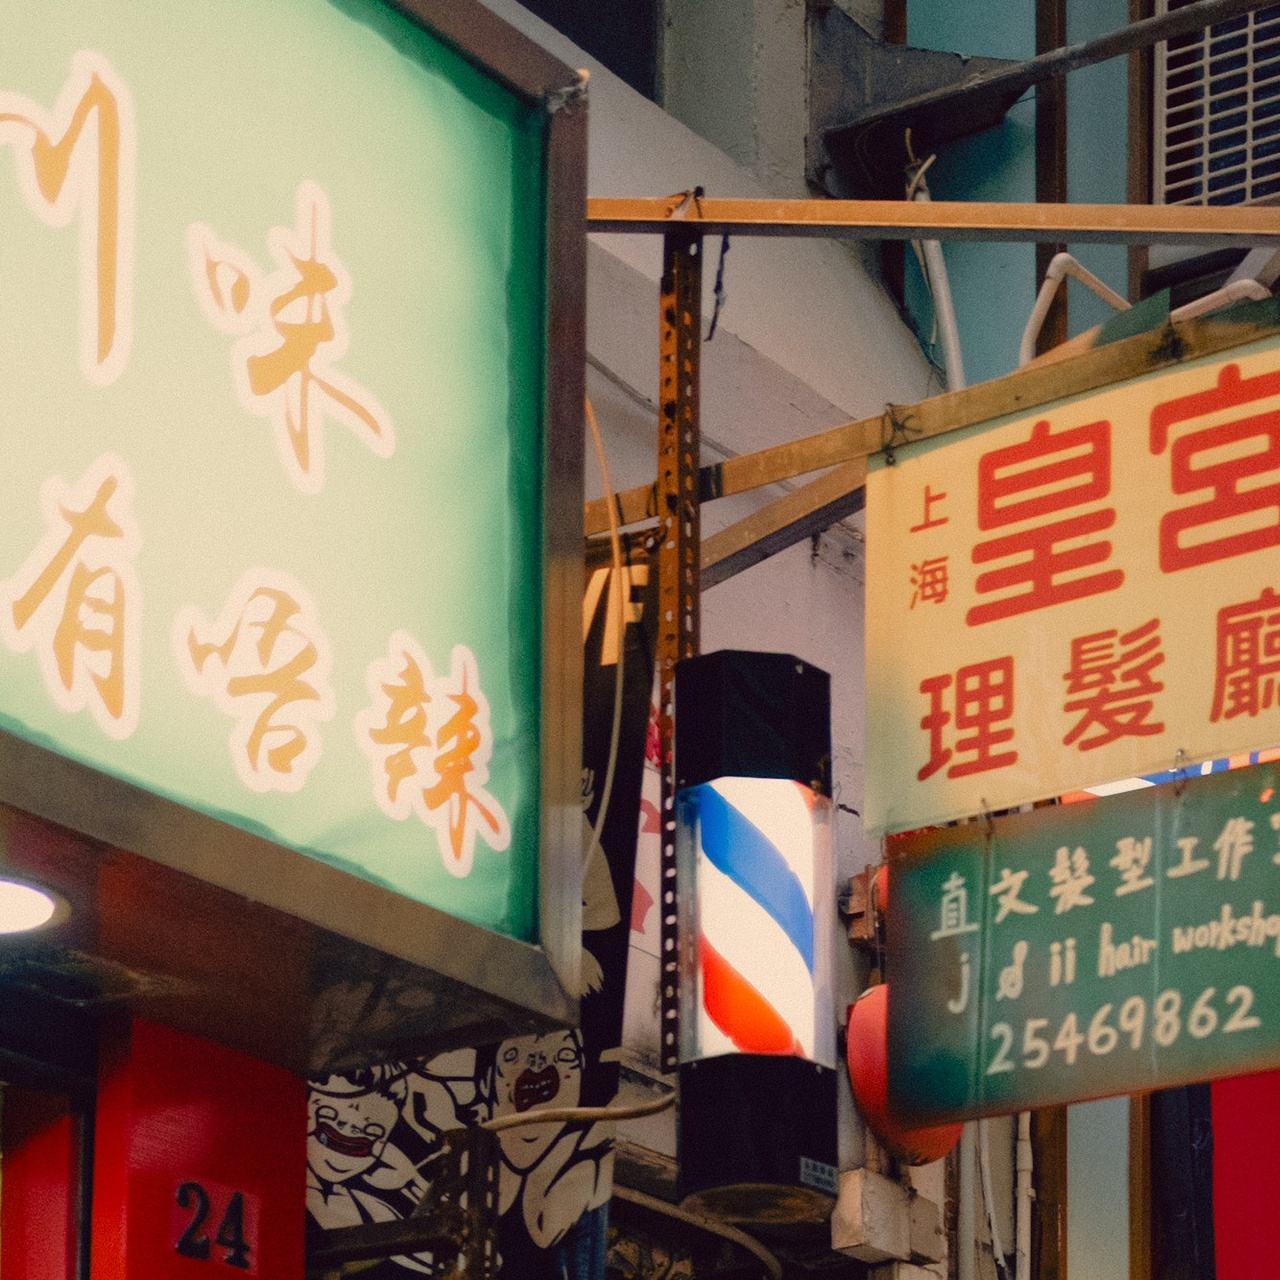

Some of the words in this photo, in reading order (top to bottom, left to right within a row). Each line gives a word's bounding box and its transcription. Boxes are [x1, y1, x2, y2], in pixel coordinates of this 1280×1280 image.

[909, 484, 950, 612] 上海
[1097, 923, 1158, 980] hair
[984, 984, 1262, 1076] 25469862
[176, 1180, 256, 1269] 24
